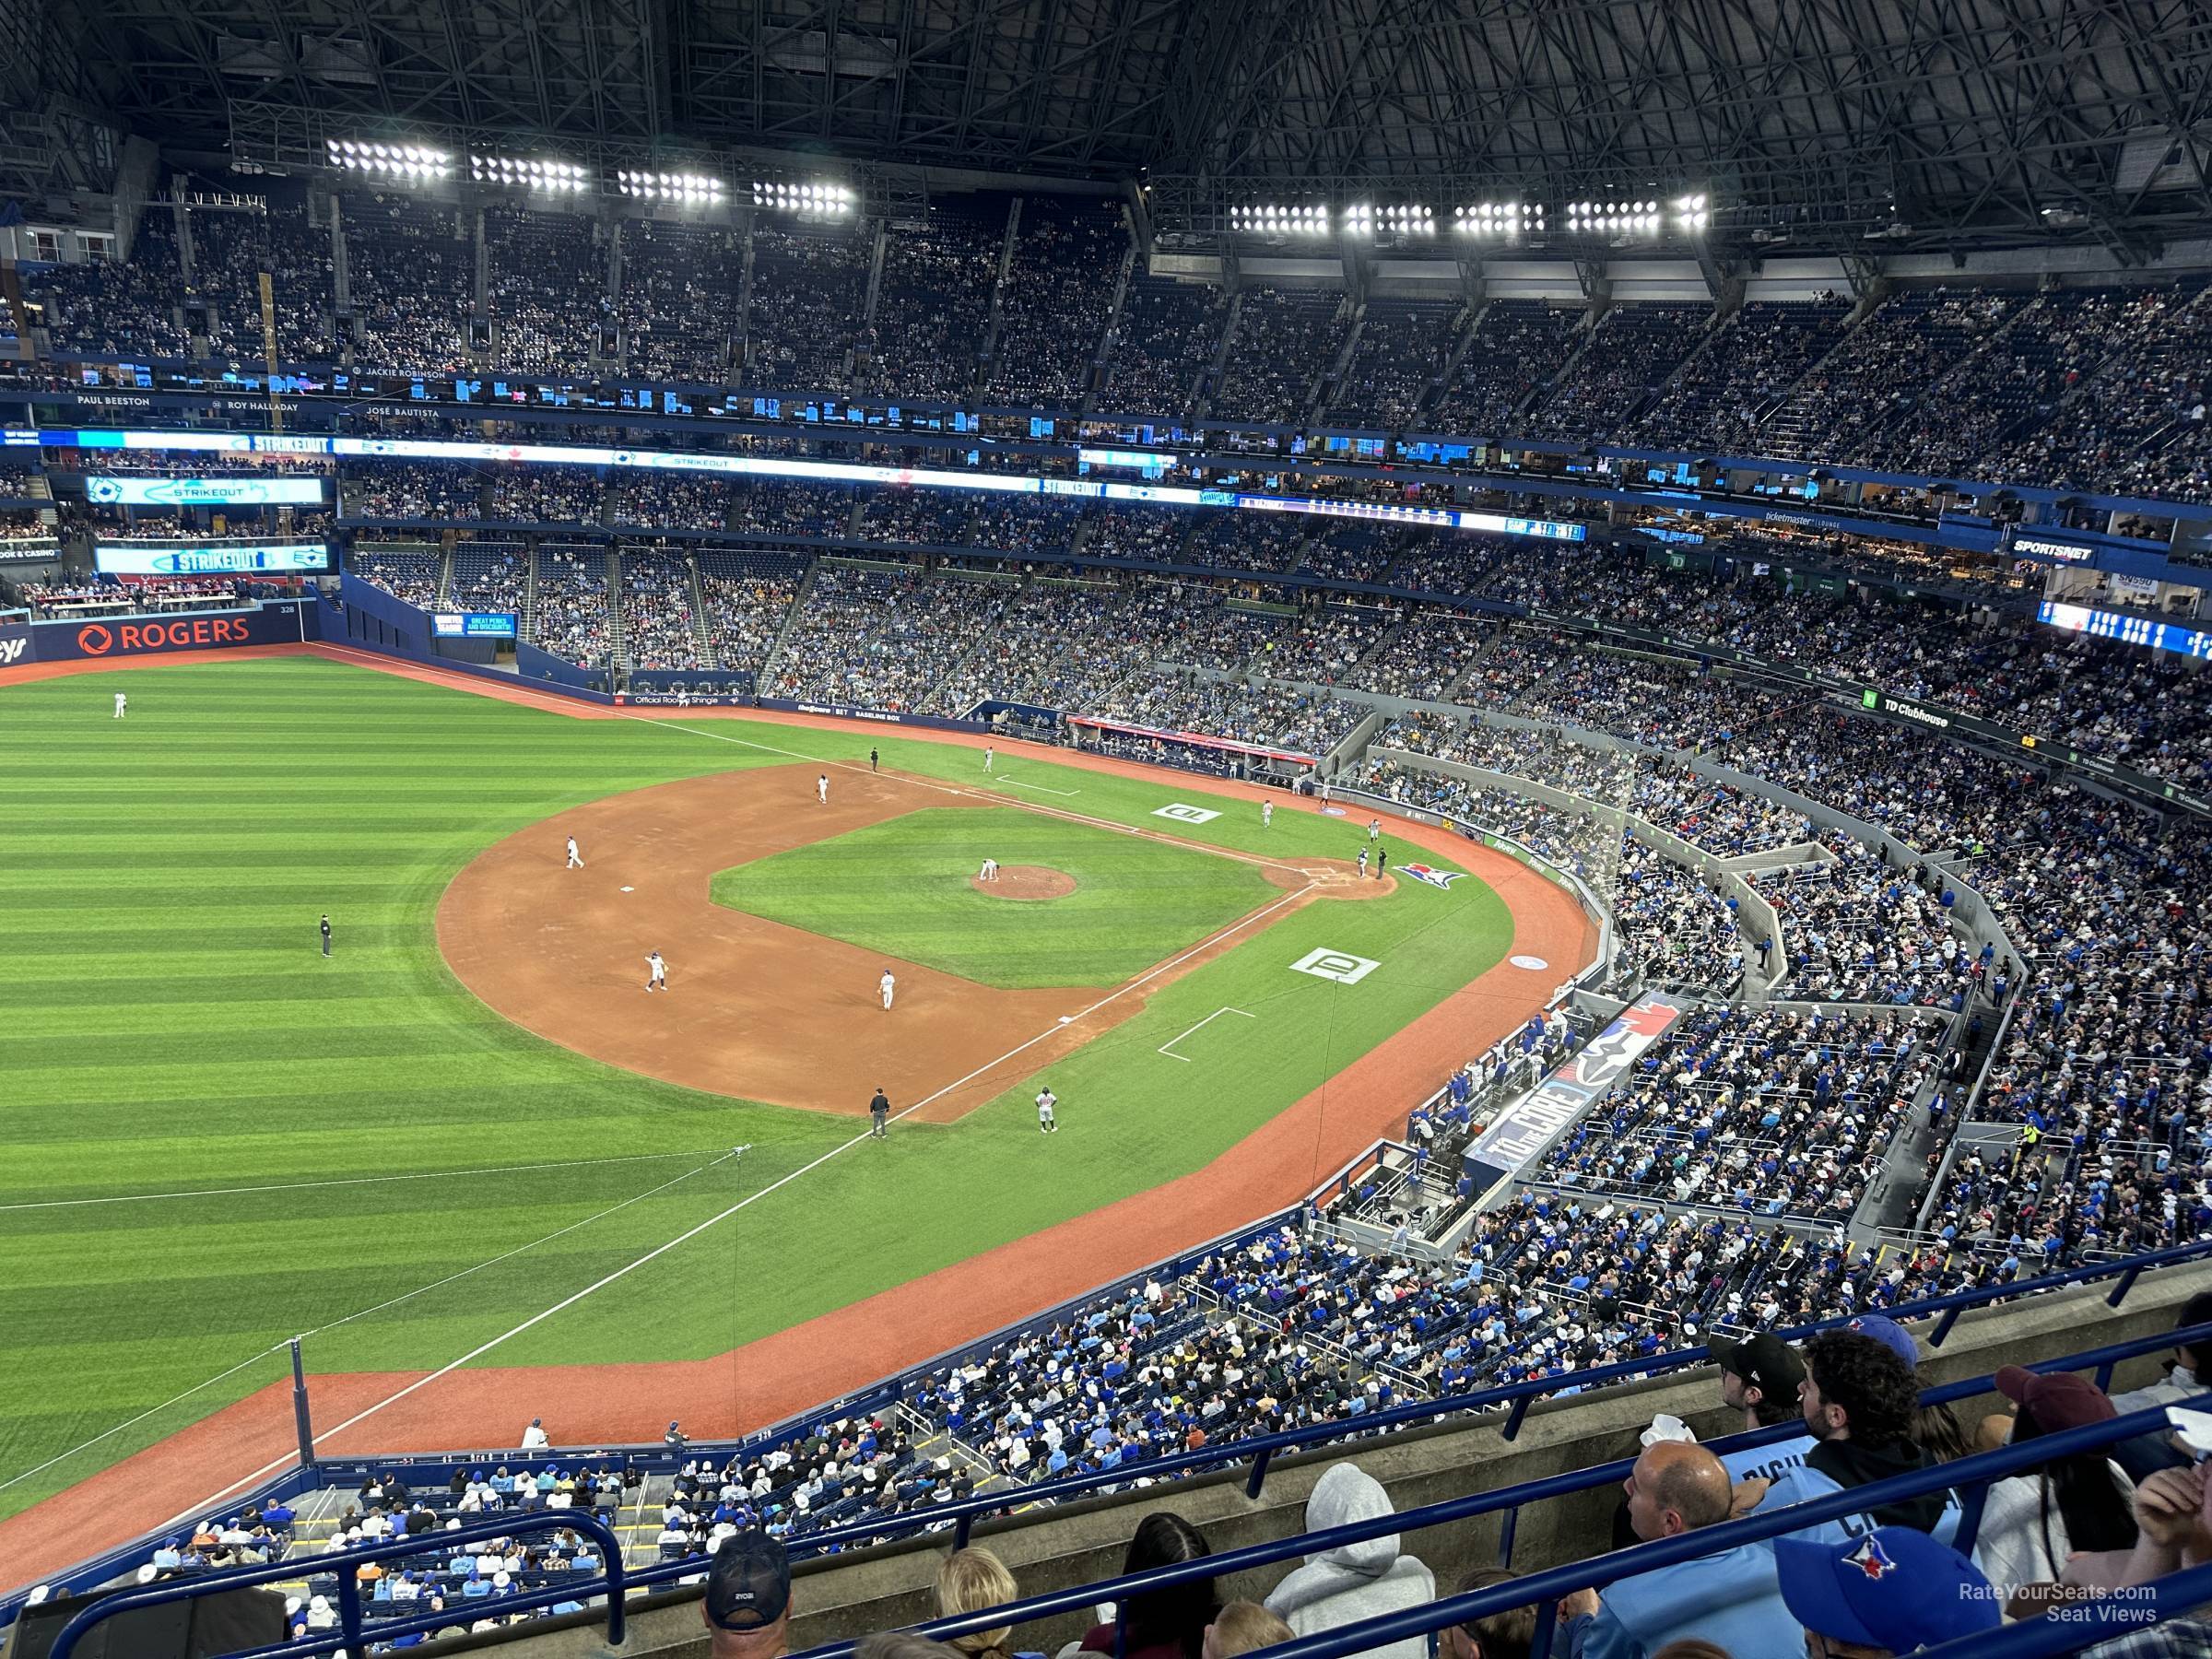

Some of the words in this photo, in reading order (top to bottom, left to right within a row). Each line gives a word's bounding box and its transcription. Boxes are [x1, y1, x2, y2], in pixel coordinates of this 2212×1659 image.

[366, 369, 397, 378] JACKIE
[399, 370, 445, 380] ROBINSON
[77, 395, 102, 405] PAUL
[105, 397, 150, 406] BEESTON
[228, 402, 247, 410] ROY
[250, 403, 299, 411] HALLADAY
[367, 406, 391, 415] JOSÉ
[394, 408, 439, 418] BAUTISTA
[254, 437, 328, 453] STRIKEOUT
[675, 458, 728, 467] STRIKEOUT
[174, 488, 243, 497] STRIKEOUT
[1043, 479, 1101, 496] STRIKEOUT
[1766, 511, 1811, 525] ticketmaster
[1818, 520, 1841, 529] LOUNGE
[25, 549, 55, 559] CASINO
[2014, 540, 2091, 560] SPORTSNET
[179, 551, 259, 570] STRIKEOUT
[280, 606, 295, 614] 328
[121, 618, 250, 649] ROGERS
[636, 696, 661, 704] Official
[692, 696, 718, 705] Shingle
[855, 711, 886, 720] BASELINE
[1885, 700, 1899, 712] TD
[1899, 704, 1948, 727] Clubhouse
[2089, 759, 2114, 773] Clubhouse
[2185, 794, 2210, 810] Clubhouse
[1415, 812, 1426, 820] BET
[1509, 1088, 1588, 1135] CORE
[1524, 1128, 1547, 1150] THE
[1488, 1131, 1526, 1160] TO
[1067, 1386, 1077, 1397] 27
[955, 1396, 965, 1406] 55
